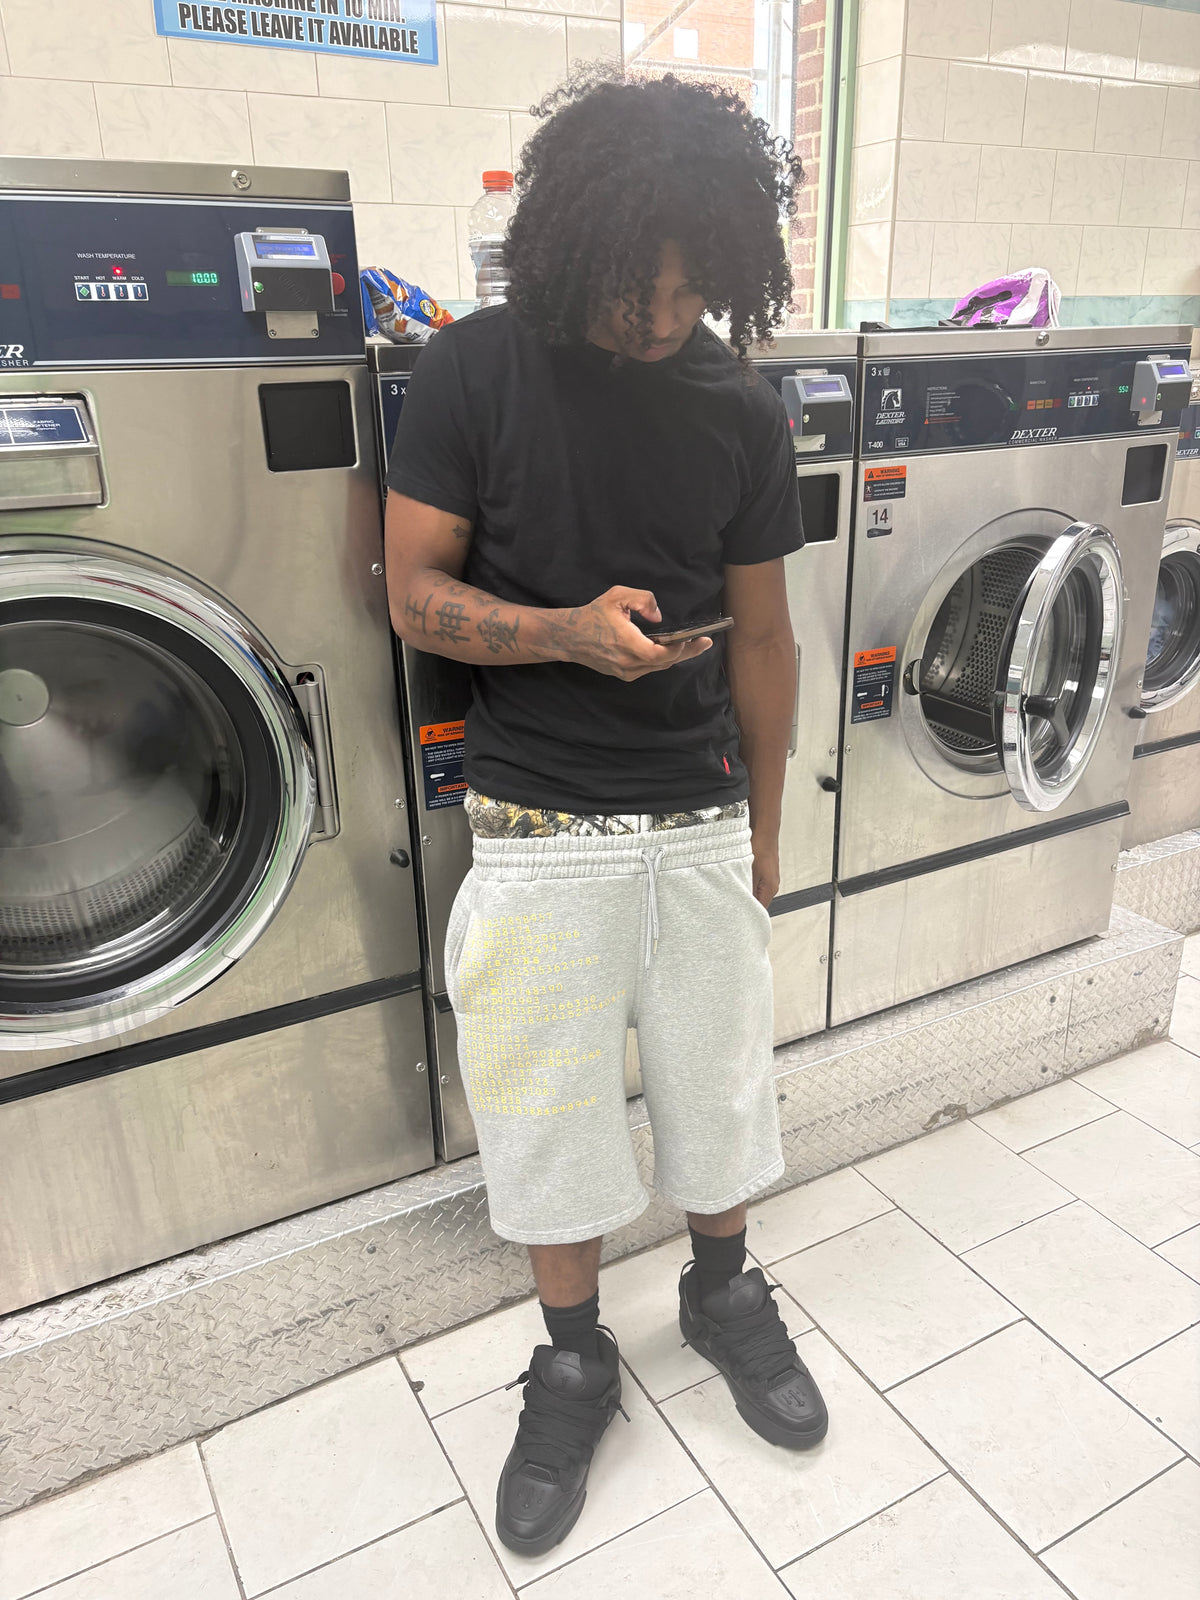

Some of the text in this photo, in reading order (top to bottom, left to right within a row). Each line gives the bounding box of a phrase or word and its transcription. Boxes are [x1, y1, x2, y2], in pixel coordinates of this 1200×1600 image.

[367, 0, 404, 23] MIN.
[178, 3, 419, 54] PLEASE LEAVE IT AVAILABLE
[94, 252, 136, 260] TEMPERATURE
[871, 367, 877, 377] 3
[390, 384, 398, 396] 3
[875, 411, 905, 419] DEXTER
[1010, 427, 1058, 440] DEXTER
[867, 440, 884, 449] T-400
[872, 507, 889, 525] 14
